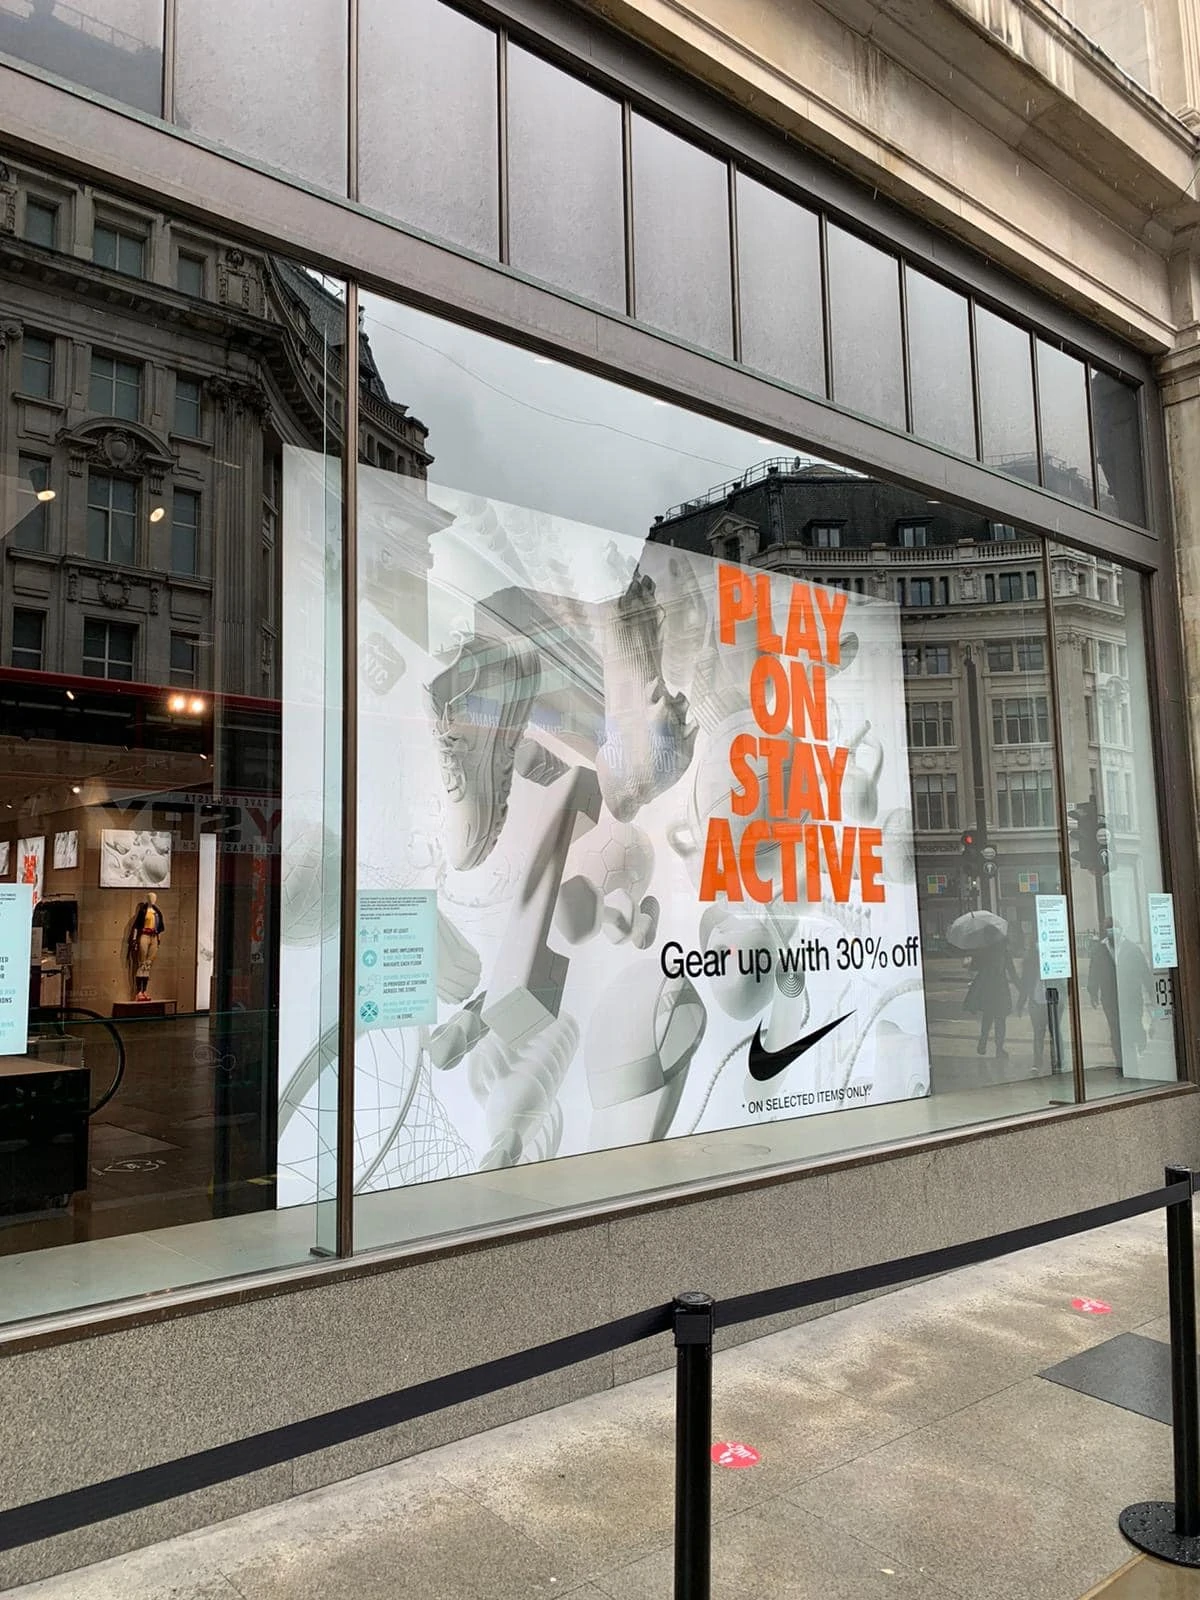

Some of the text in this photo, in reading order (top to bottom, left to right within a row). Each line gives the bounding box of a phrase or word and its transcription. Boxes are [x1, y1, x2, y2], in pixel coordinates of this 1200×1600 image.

[718, 563, 849, 666] PLAY
[750, 654, 828, 742] ON
[729, 733, 850, 822] STAY
[700, 817, 886, 904] ACTIVE
[661, 936, 919, 983] Gear up with 30% off
[748, 1100, 763, 1114] ON
[766, 1093, 815, 1111] SELECTED
[817, 1088, 844, 1103] ITEMS
